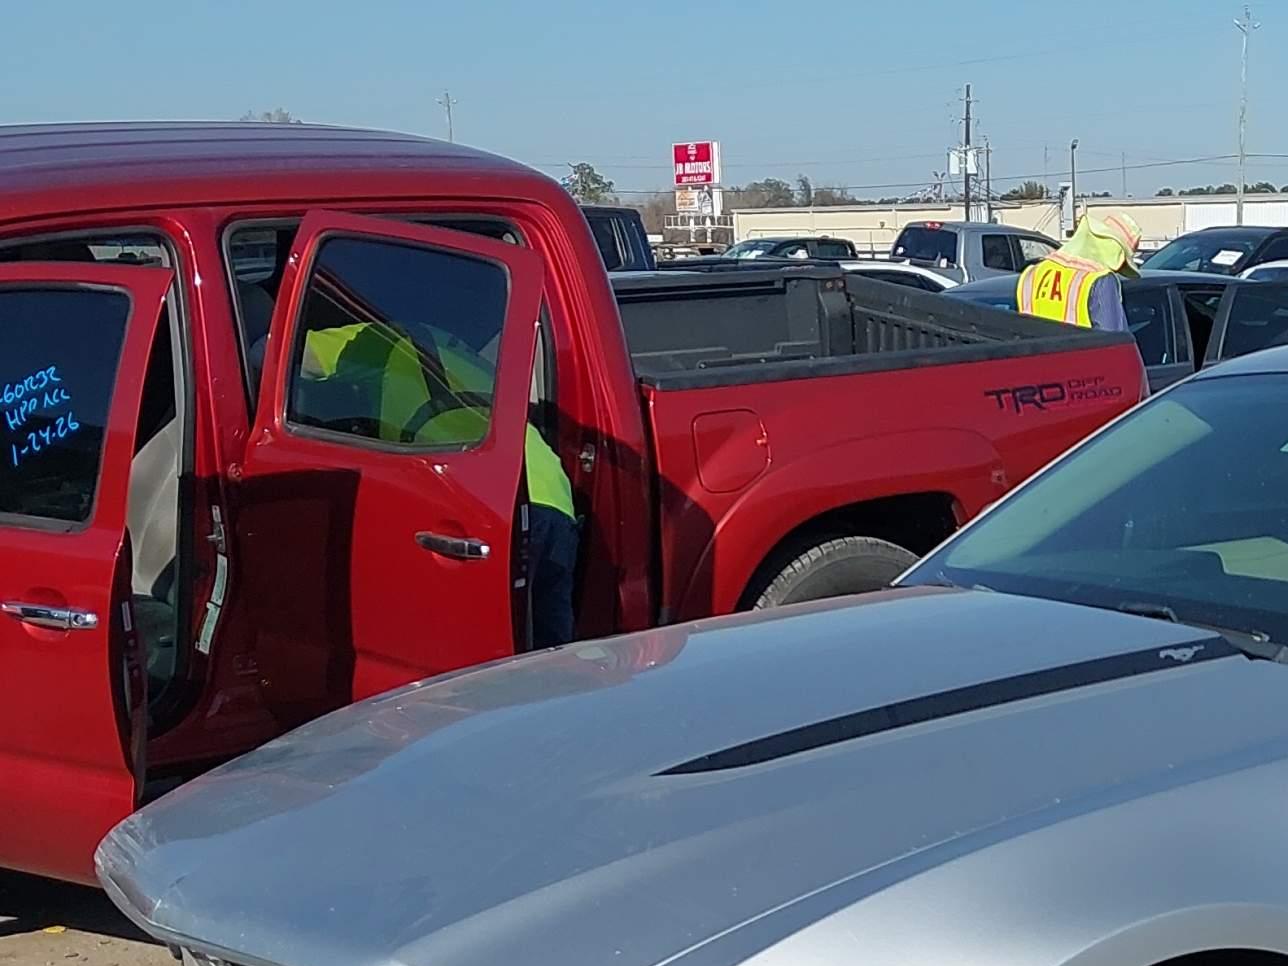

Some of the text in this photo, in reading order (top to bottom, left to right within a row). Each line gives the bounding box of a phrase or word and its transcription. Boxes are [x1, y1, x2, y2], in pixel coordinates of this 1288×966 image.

[685, 161, 711, 173] MOTORS
[984, 383, 1065, 415] TRD
[1070, 386, 1122, 401] ROAD
